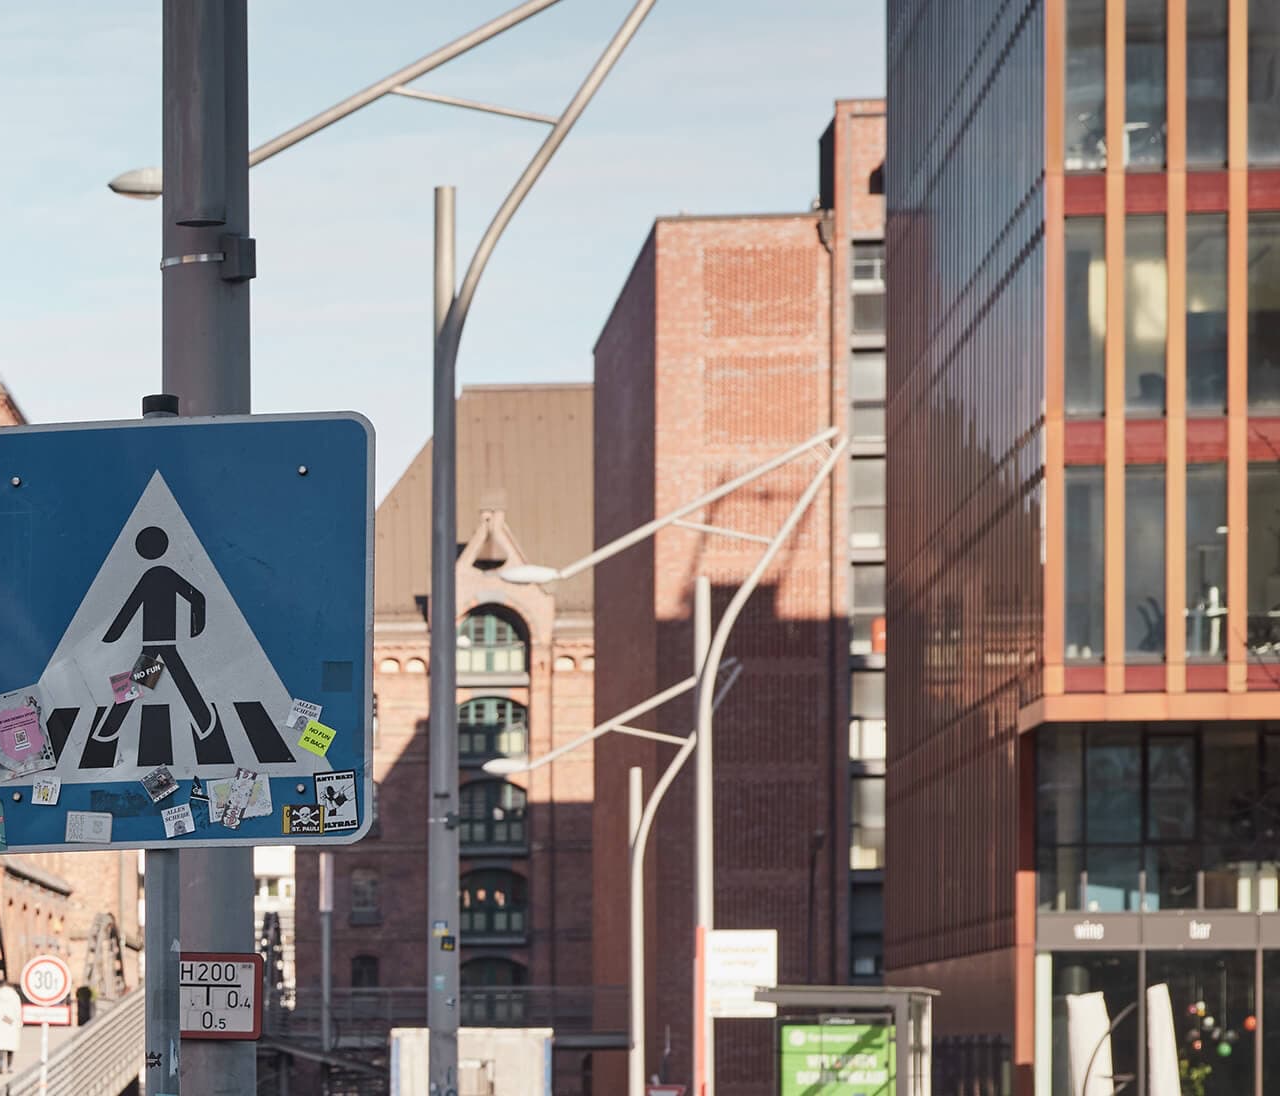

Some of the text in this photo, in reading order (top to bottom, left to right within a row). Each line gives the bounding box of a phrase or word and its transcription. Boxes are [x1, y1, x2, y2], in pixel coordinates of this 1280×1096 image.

[133, 671, 145, 680] NO
[146, 664, 161, 675] FUN
[166, 806, 186, 816] ALLES
[1073, 920, 1211, 939] wine bar
[202, 1011, 227, 1030] 0.5
